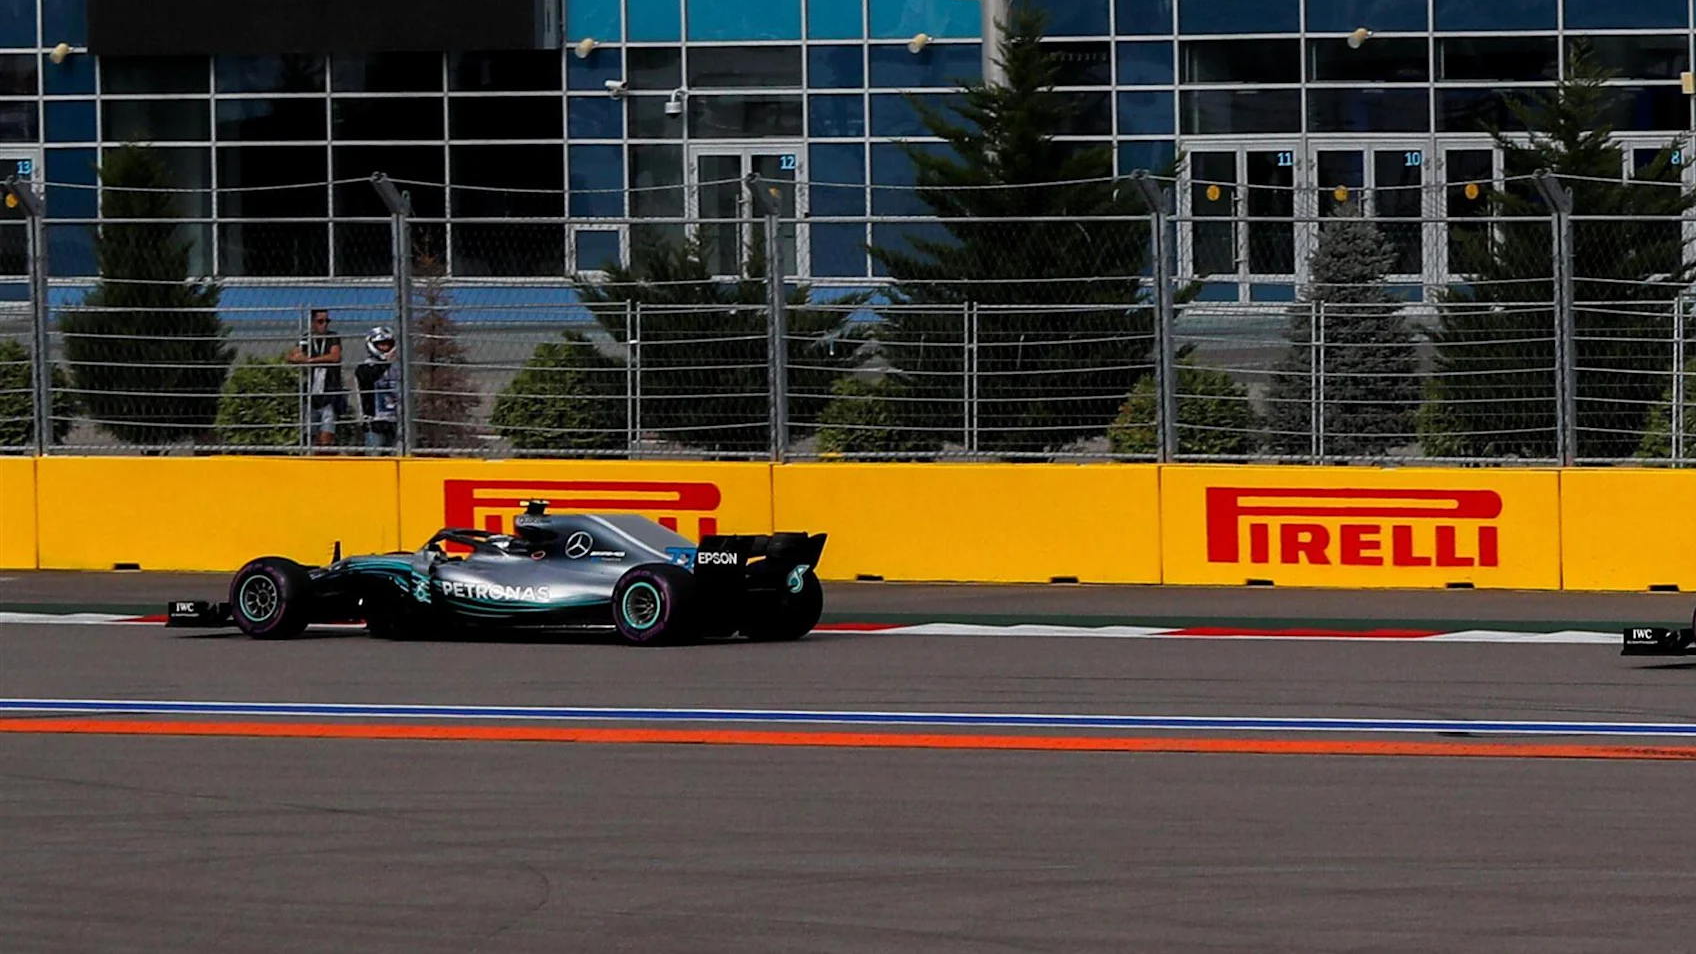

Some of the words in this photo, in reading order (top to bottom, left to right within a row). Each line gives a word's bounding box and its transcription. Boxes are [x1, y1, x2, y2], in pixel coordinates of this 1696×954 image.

[780, 156, 796, 170] 12
[1277, 152, 1293, 167] 11
[1404, 152, 1421, 167] 10
[1670, 150, 1680, 165] 8
[16, 160, 32, 175] 13
[1206, 487, 1502, 567] PIRELLI
[698, 552, 738, 565] EPSON
[442, 581, 550, 603] PETRONAS
[176, 602, 195, 612] IWC
[1632, 628, 1653, 639] IWC
